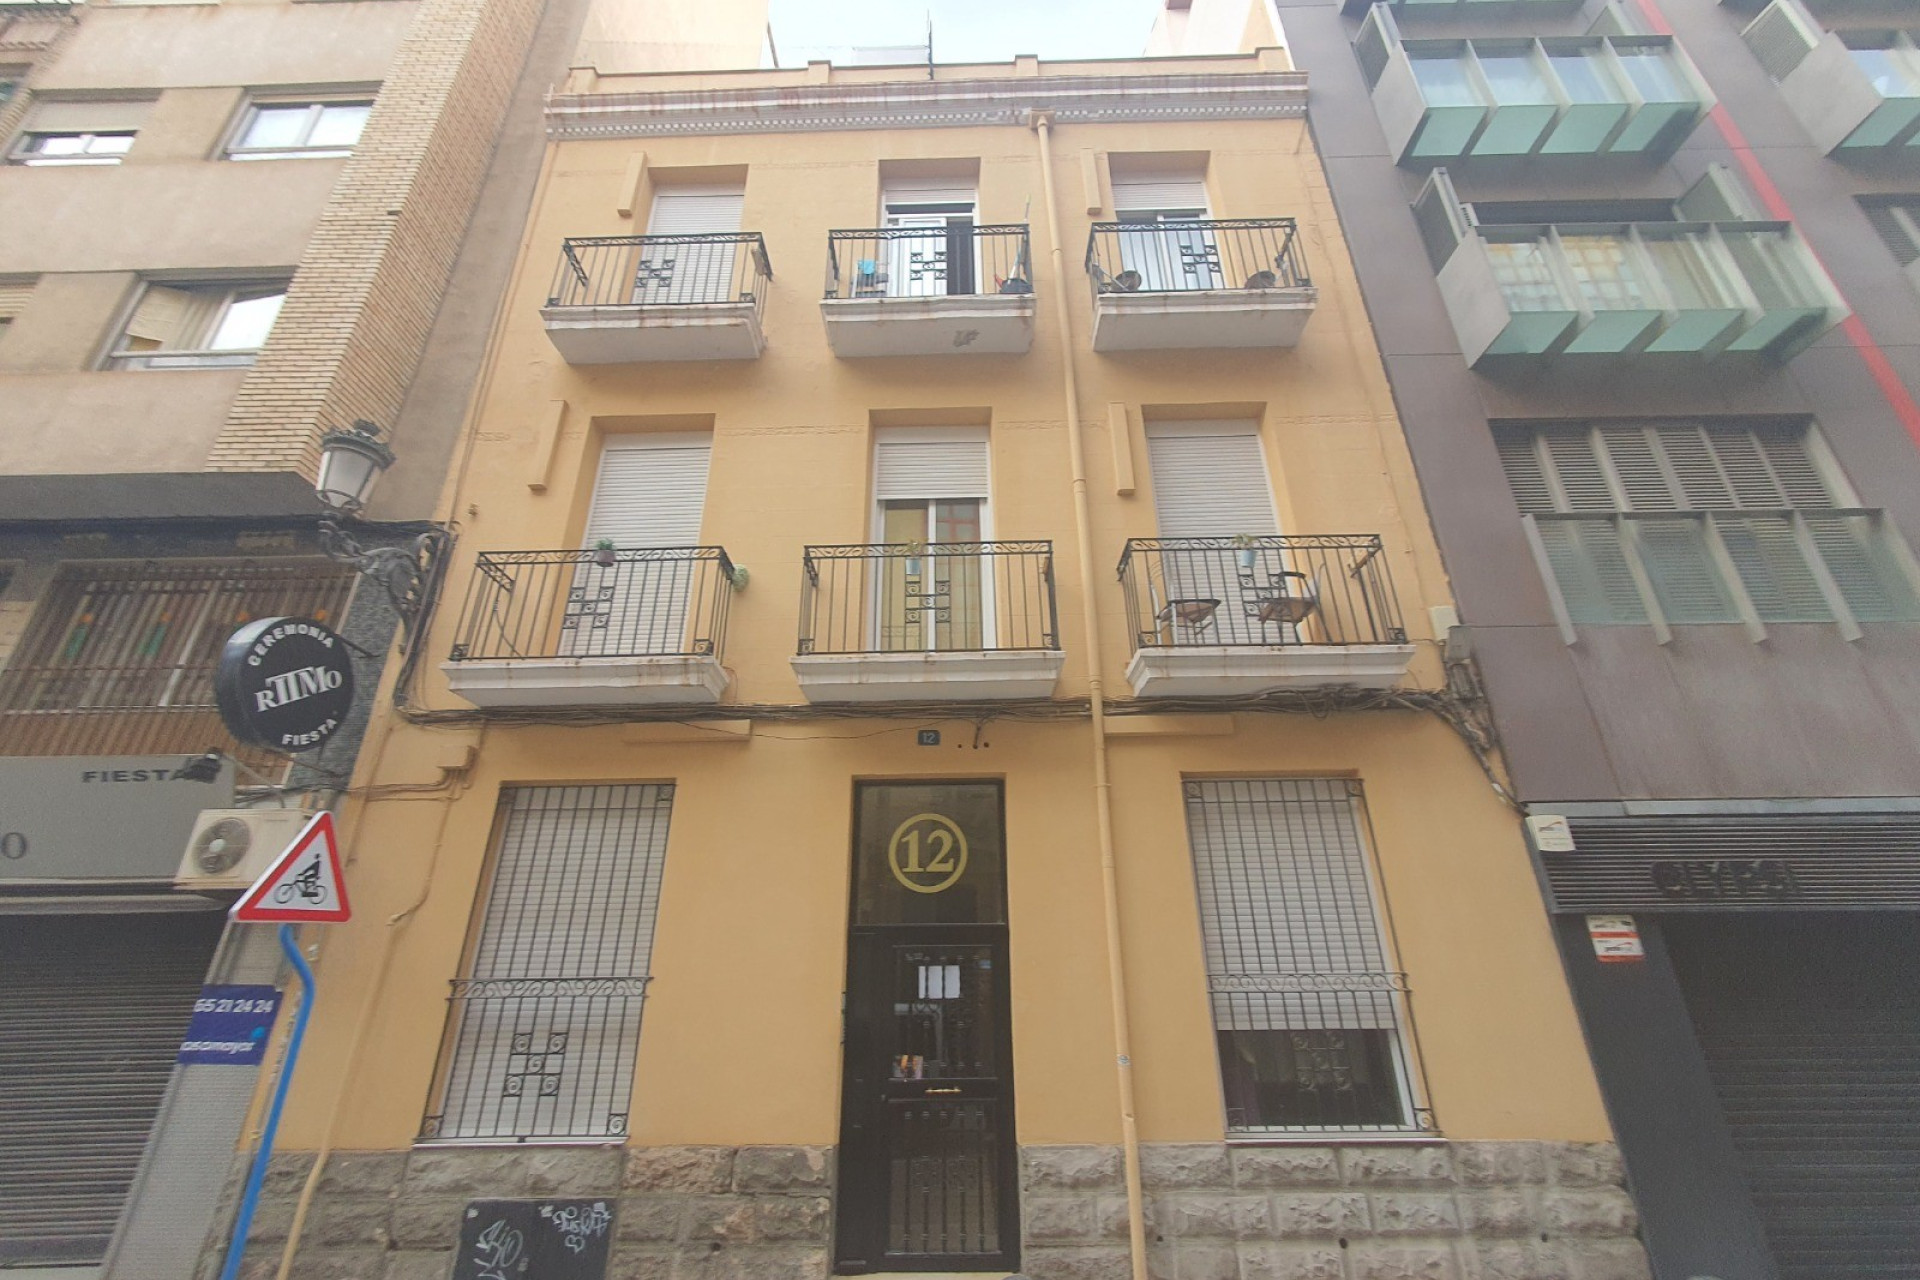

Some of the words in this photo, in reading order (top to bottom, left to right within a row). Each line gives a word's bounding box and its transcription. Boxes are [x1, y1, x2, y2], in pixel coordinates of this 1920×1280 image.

[247, 623, 335, 667] CEREMONIA
[281, 718, 338, 746] FIESTA
[922, 731, 937, 744] 12
[900, 828, 955, 873] 12
